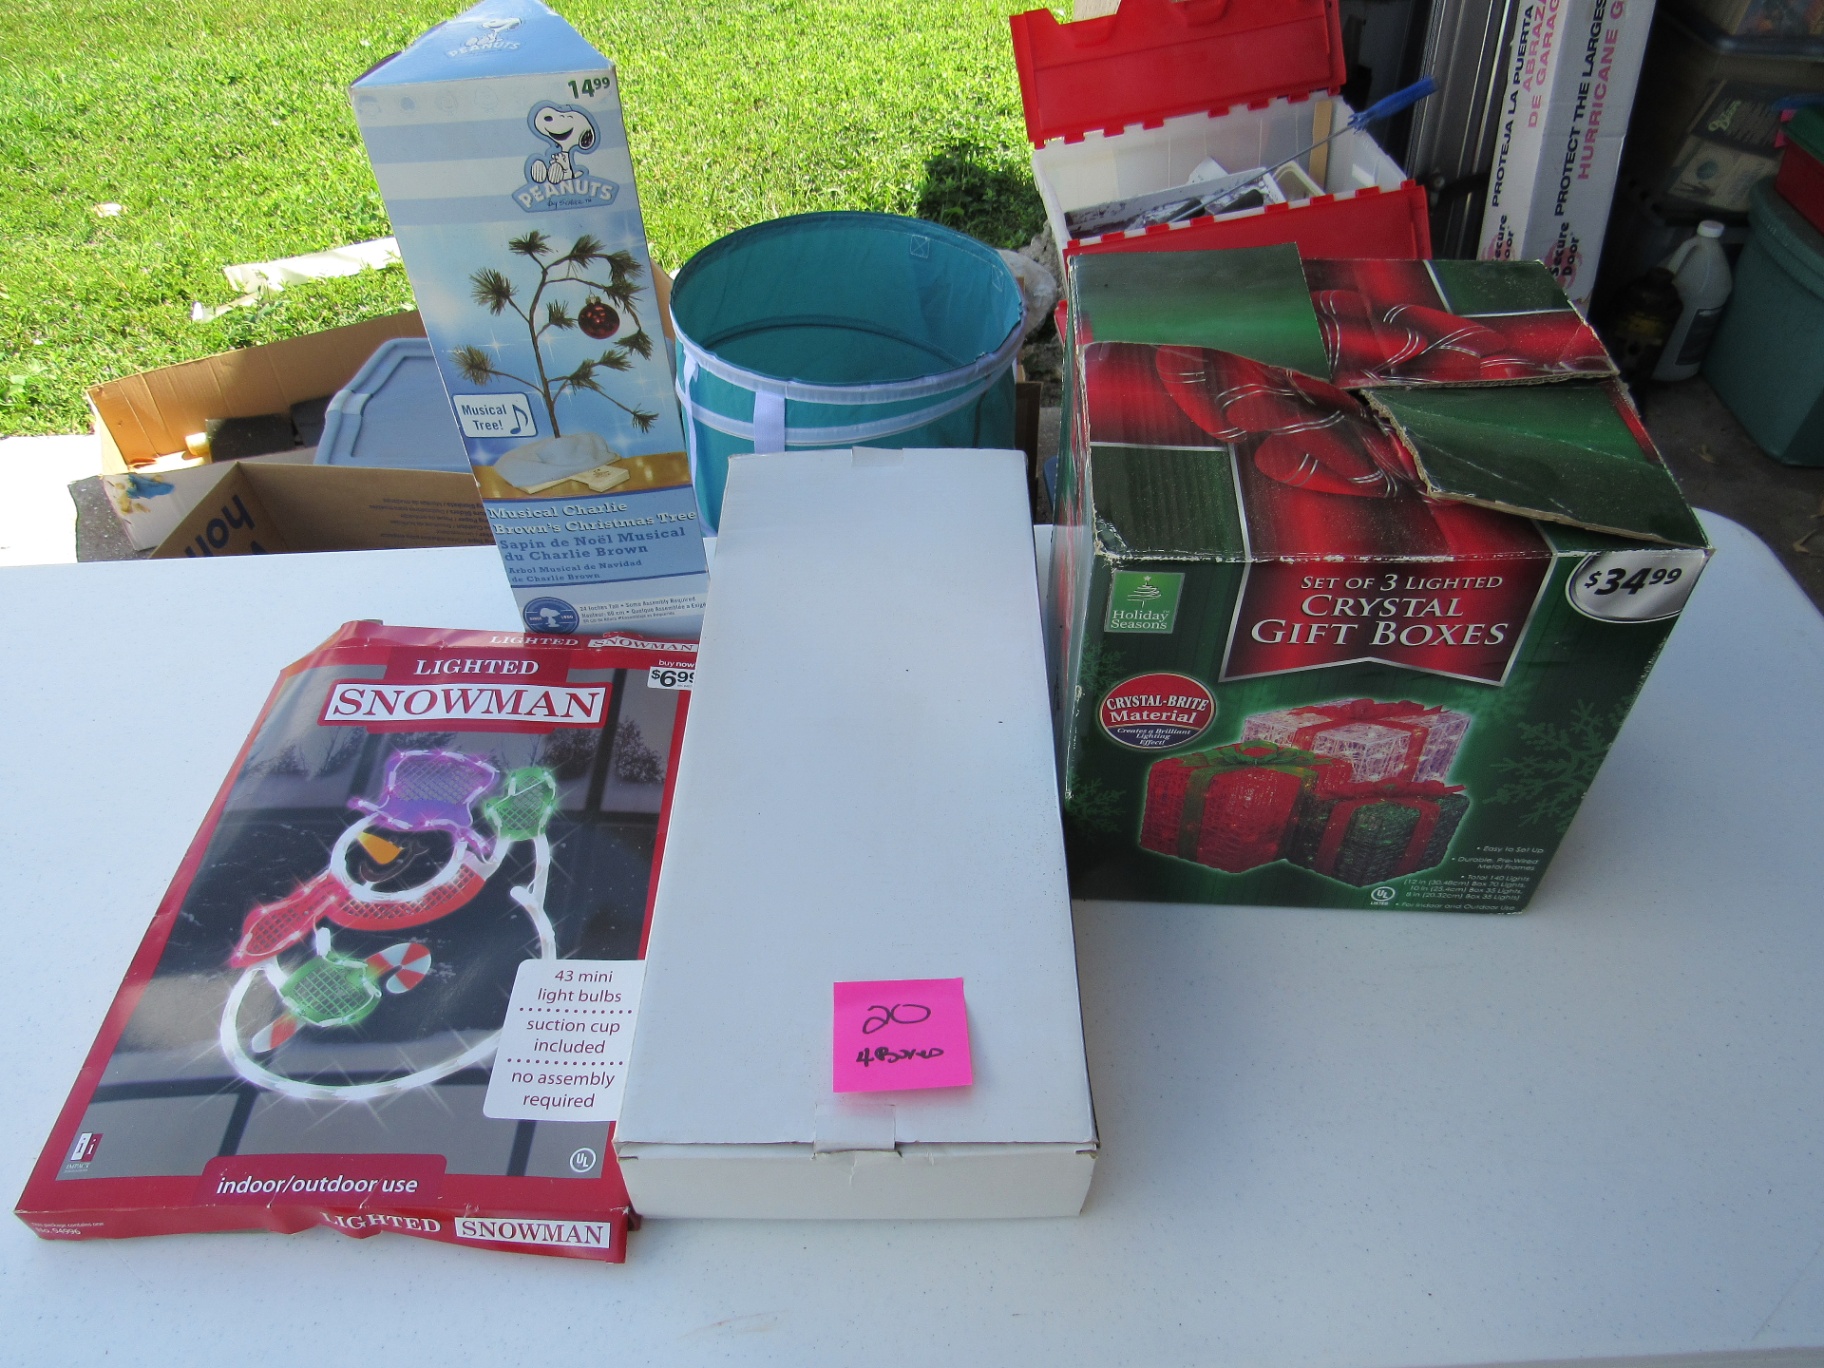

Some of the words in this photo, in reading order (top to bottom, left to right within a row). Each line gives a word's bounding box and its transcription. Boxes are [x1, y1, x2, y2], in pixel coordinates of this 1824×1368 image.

[1491, 120, 1514, 207] PROTEJA
[1508, 90, 1518, 114] LA
[1513, 5, 1534, 85] PUERTA
[1528, 95, 1542, 128] DE
[1578, 29, 1619, 180] HURRICANE
[1554, 127, 1581, 216] PROTECT
[1573, 83, 1590, 122] THE
[518, 179, 613, 208] PEANUTS
[1494, 215, 1507, 259] ecure
[1504, 230, 1514, 259] oor
[1550, 222, 1569, 276] Secure
[1562, 237, 1580, 276] Door
[461, 403, 507, 417] Musical
[472, 419, 504, 431] Tree!
[488, 507, 558, 520] Musical
[562, 502, 628, 517] Charlie
[493, 522, 561, 535] Brown's
[565, 515, 654, 533] Christmas
[657, 511, 697, 523] Tree
[500, 538, 546, 552] Sapin
[551, 538, 569, 548] de
[574, 534, 614, 546] Noël
[618, 527, 686, 543] Musical
[504, 551, 524, 561] du
[529, 548, 591, 561] Charlie
[596, 544, 648, 557] Brown
[539, 564, 582, 574] Musical
[584, 563, 596, 571] de
[599, 559, 642, 569] Navidad
[527, 574, 564, 583] Charlie
[567, 572, 600, 581] Brown
[1301, 576, 1340, 590] SET
[1345, 577, 1375, 590] OF
[1383, 574, 1399, 592] 3
[1404, 575, 1503, 590] LIGHTED
[1300, 594, 1464, 618] CRYSTAL
[1112, 609, 1168, 621] Holiday
[1251, 618, 1358, 646] GIFT
[1369, 620, 1508, 647] BOXES
[489, 635, 579, 646] LIGHTED
[593, 637, 694, 651] SNOWMAN
[414, 659, 540, 676] LIGHTED
[658, 659, 676, 668] buy
[333, 688, 600, 719] SNOWMAN
[1106, 694, 1210, 711] CRYSTAL-BRITE
[1110, 709, 1197, 724] Material
[1155, 727, 1191, 735] Brilliant
[1483, 845, 1502, 853] Easy
[1497, 857, 1539, 865] Pre-Wired
[1505, 875, 1531, 883] Lights
[555, 970, 574, 982] 43
[578, 970, 613, 983] mini
[537, 988, 574, 1004] light
[578, 989, 622, 1003] bulbs
[526, 1019, 586, 1033] suction
[590, 1022, 621, 1035] cup
[862, 1003, 931, 1034] 20
[534, 1039, 606, 1054] included
[511, 1071, 533, 1084] no
[537, 1071, 615, 1089] assembly
[523, 1093, 596, 1110] required
[216, 1175, 377, 1195] indoor/outdoor
[382, 1179, 418, 1193] use
[320, 1211, 442, 1233] LIGHTED
[461, 1221, 603, 1245] SNOWMAN
